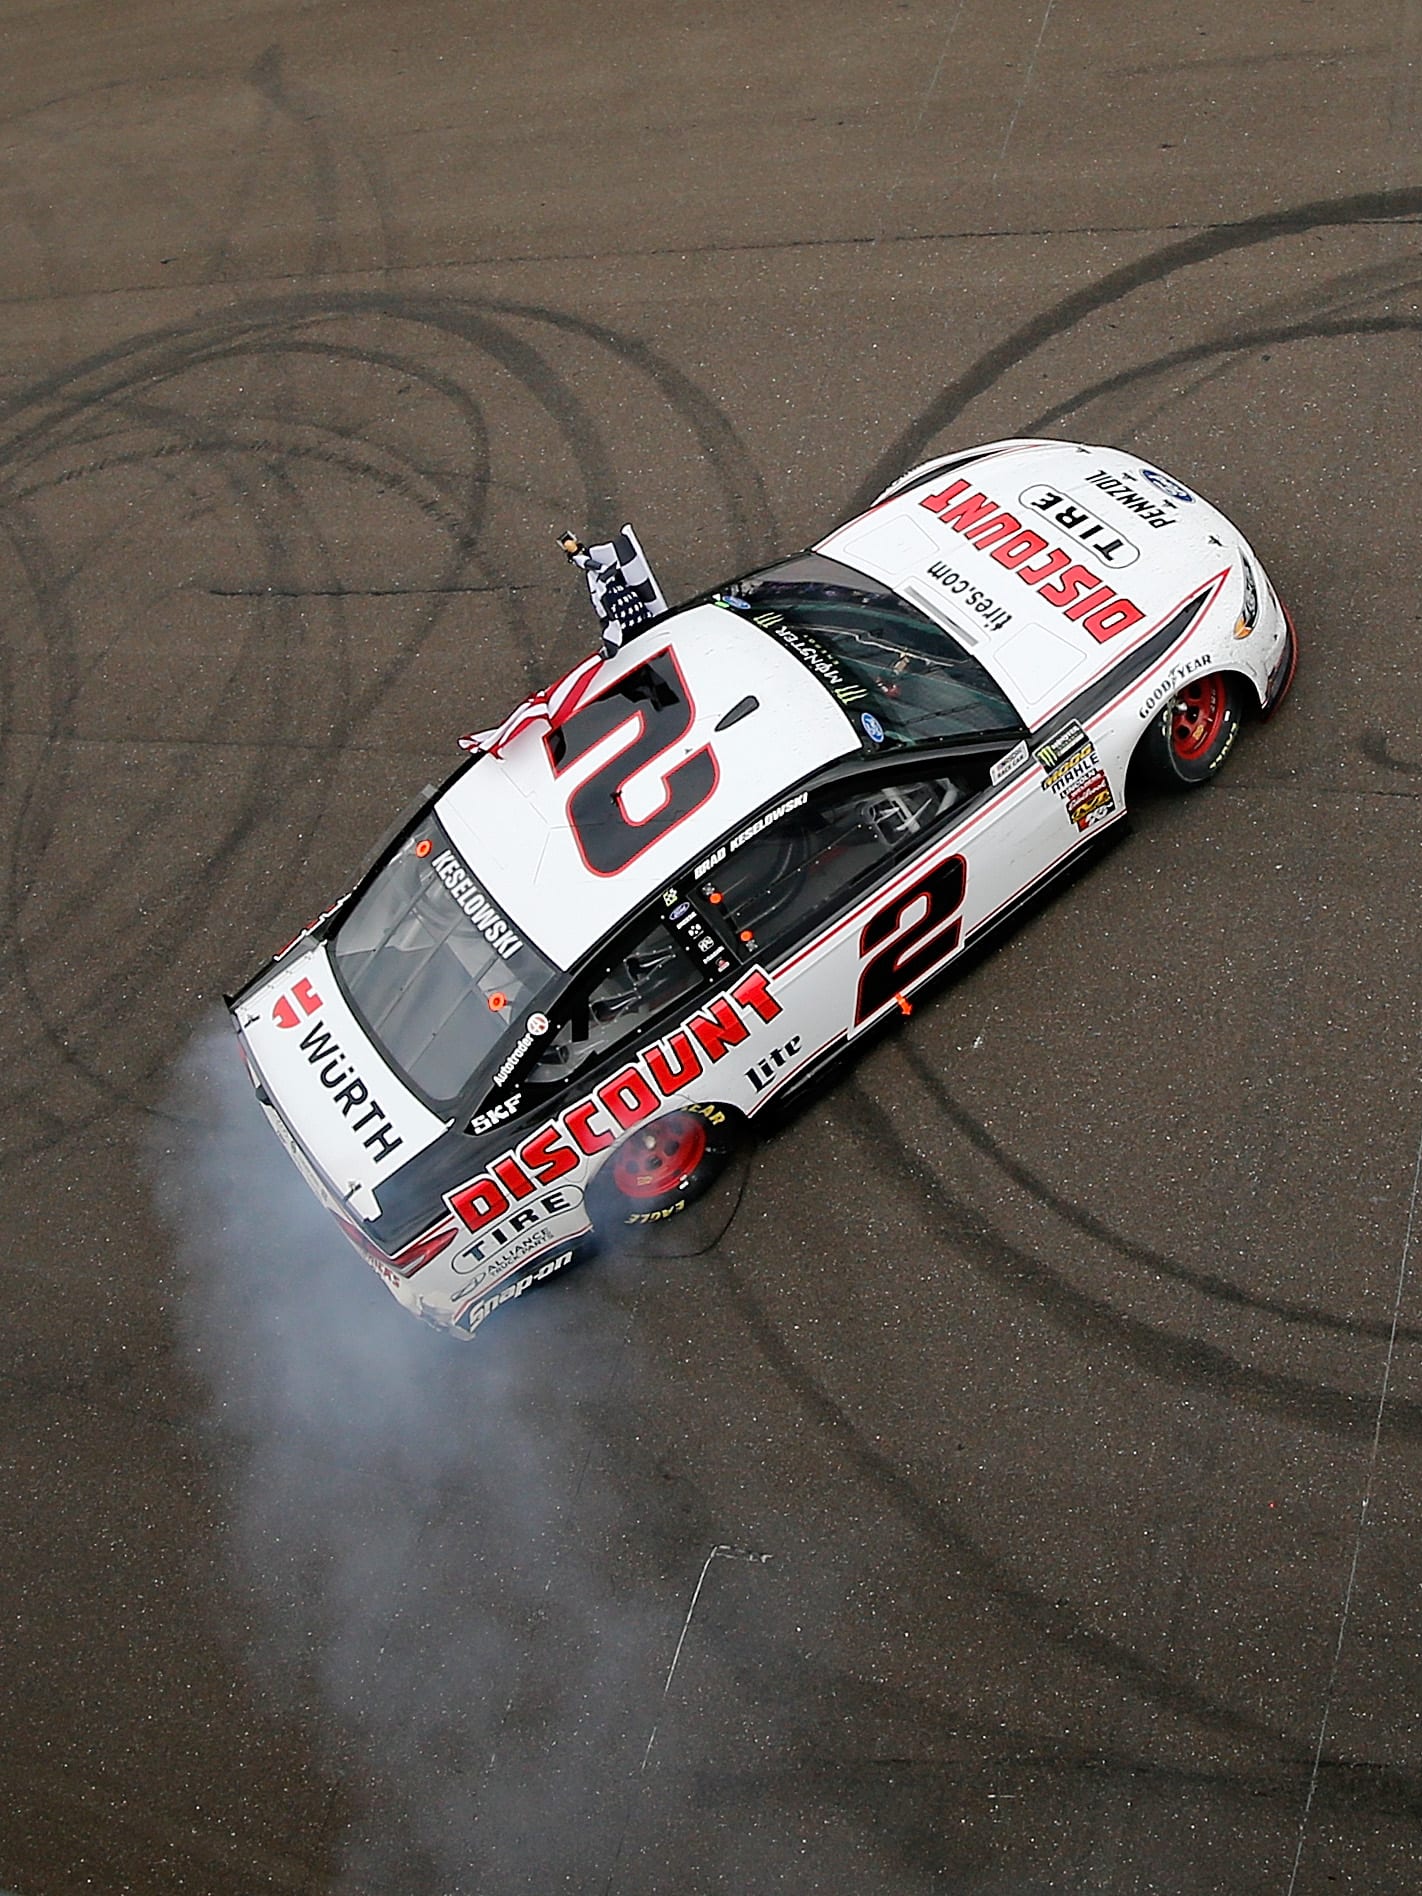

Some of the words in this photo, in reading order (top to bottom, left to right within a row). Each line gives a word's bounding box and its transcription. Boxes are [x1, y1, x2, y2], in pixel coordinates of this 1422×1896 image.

[1031, 491, 1123, 562] TIRE
[1085, 469, 1176, 529] PENNZOIL
[918, 478, 1146, 644] DISCOUNT
[926, 560, 1013, 632] tires.com
[542, 643, 720, 878] 2
[1051, 752, 1100, 794] MAHLE
[693, 847, 726, 880] BRAD
[729, 791, 808, 852] KESELOWSKI
[431, 848, 525, 961] KESELOWSKI
[853, 852, 968, 1029] 2
[298, 1020, 404, 1165] WÜRTH
[449, 968, 784, 1235] DISCOUNT
[492, 1032, 535, 1088] Autotrader
[471, 1092, 523, 1136] SKF
[462, 1191, 571, 1262] TIRE
[469, 1250, 574, 1334] Snap-on
